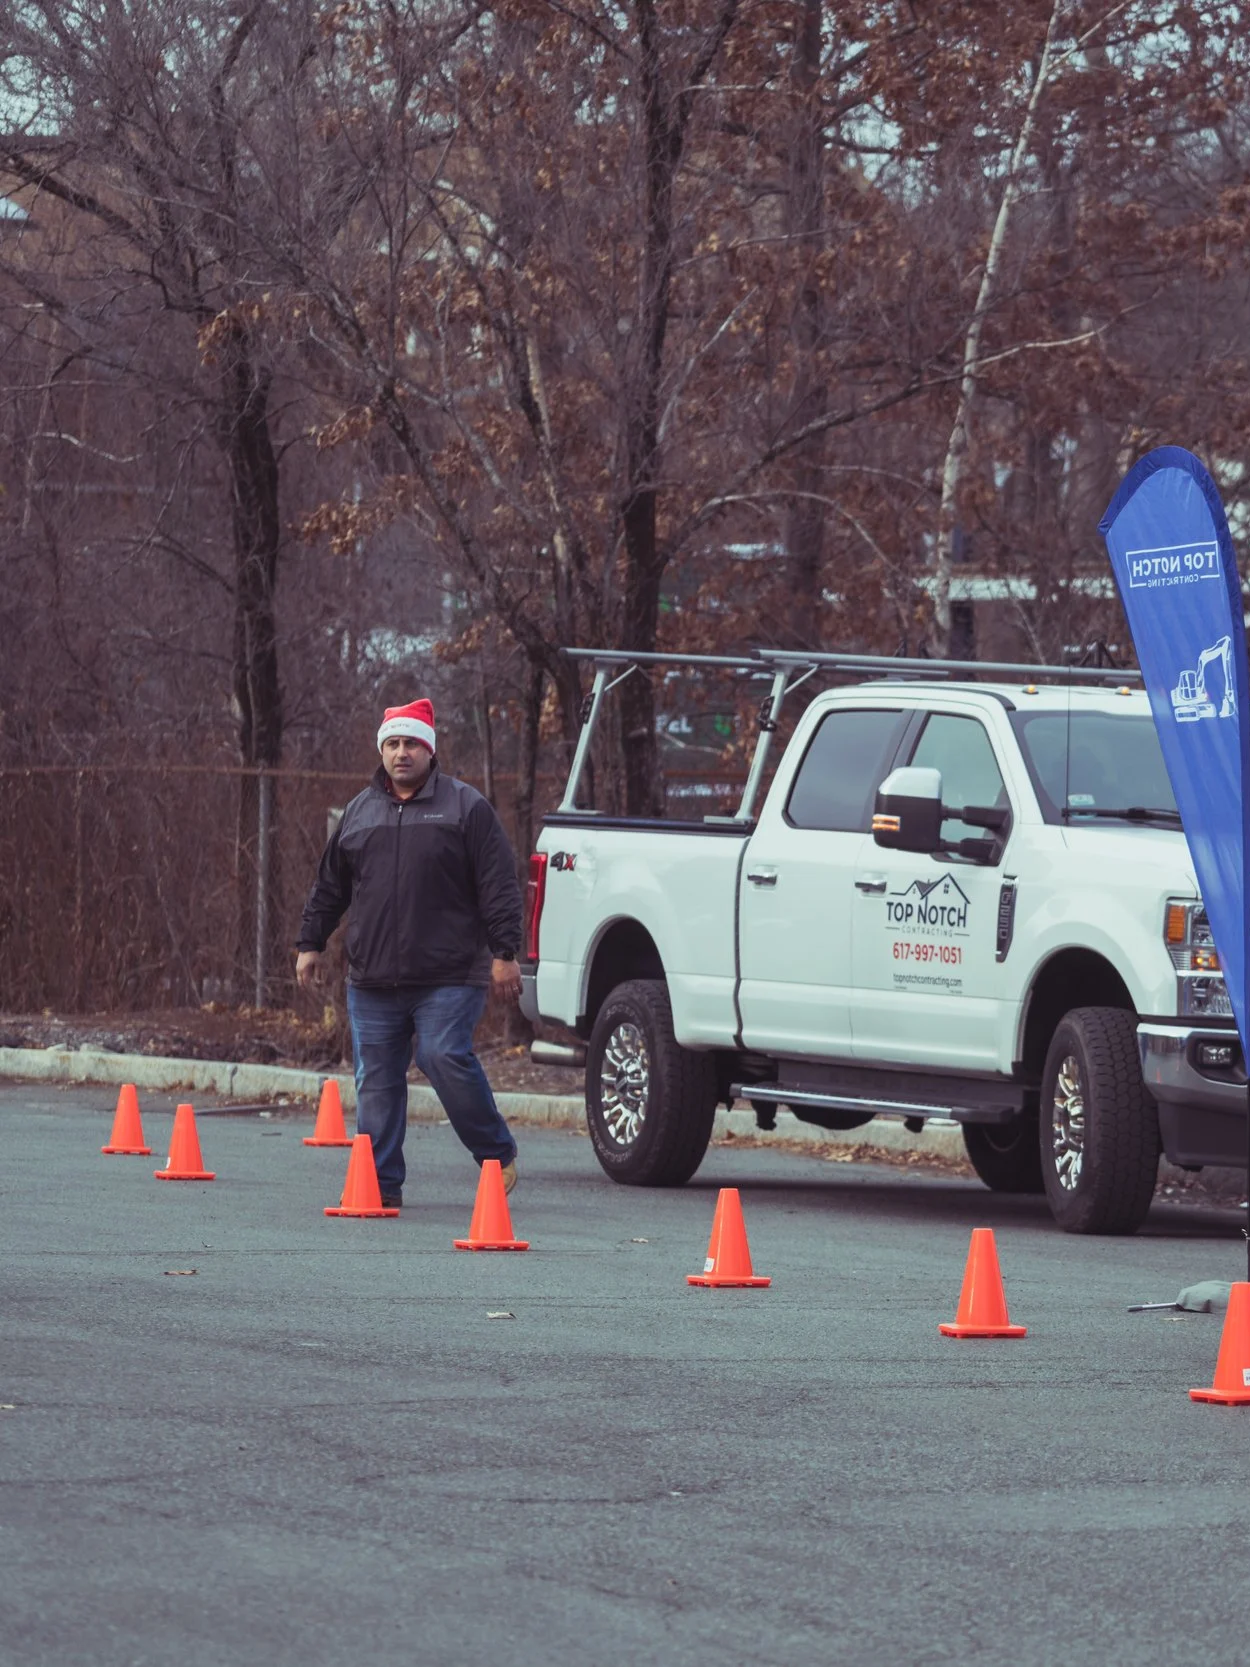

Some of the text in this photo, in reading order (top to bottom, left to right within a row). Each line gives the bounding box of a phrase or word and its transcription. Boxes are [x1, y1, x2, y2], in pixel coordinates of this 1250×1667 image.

[886, 895, 968, 928] TOP NOTCH
[901, 926, 953, 938] CONTRACTING
[893, 942, 962, 964] 617-997-1051
[893, 973, 962, 988] topnotchcontracting.com
